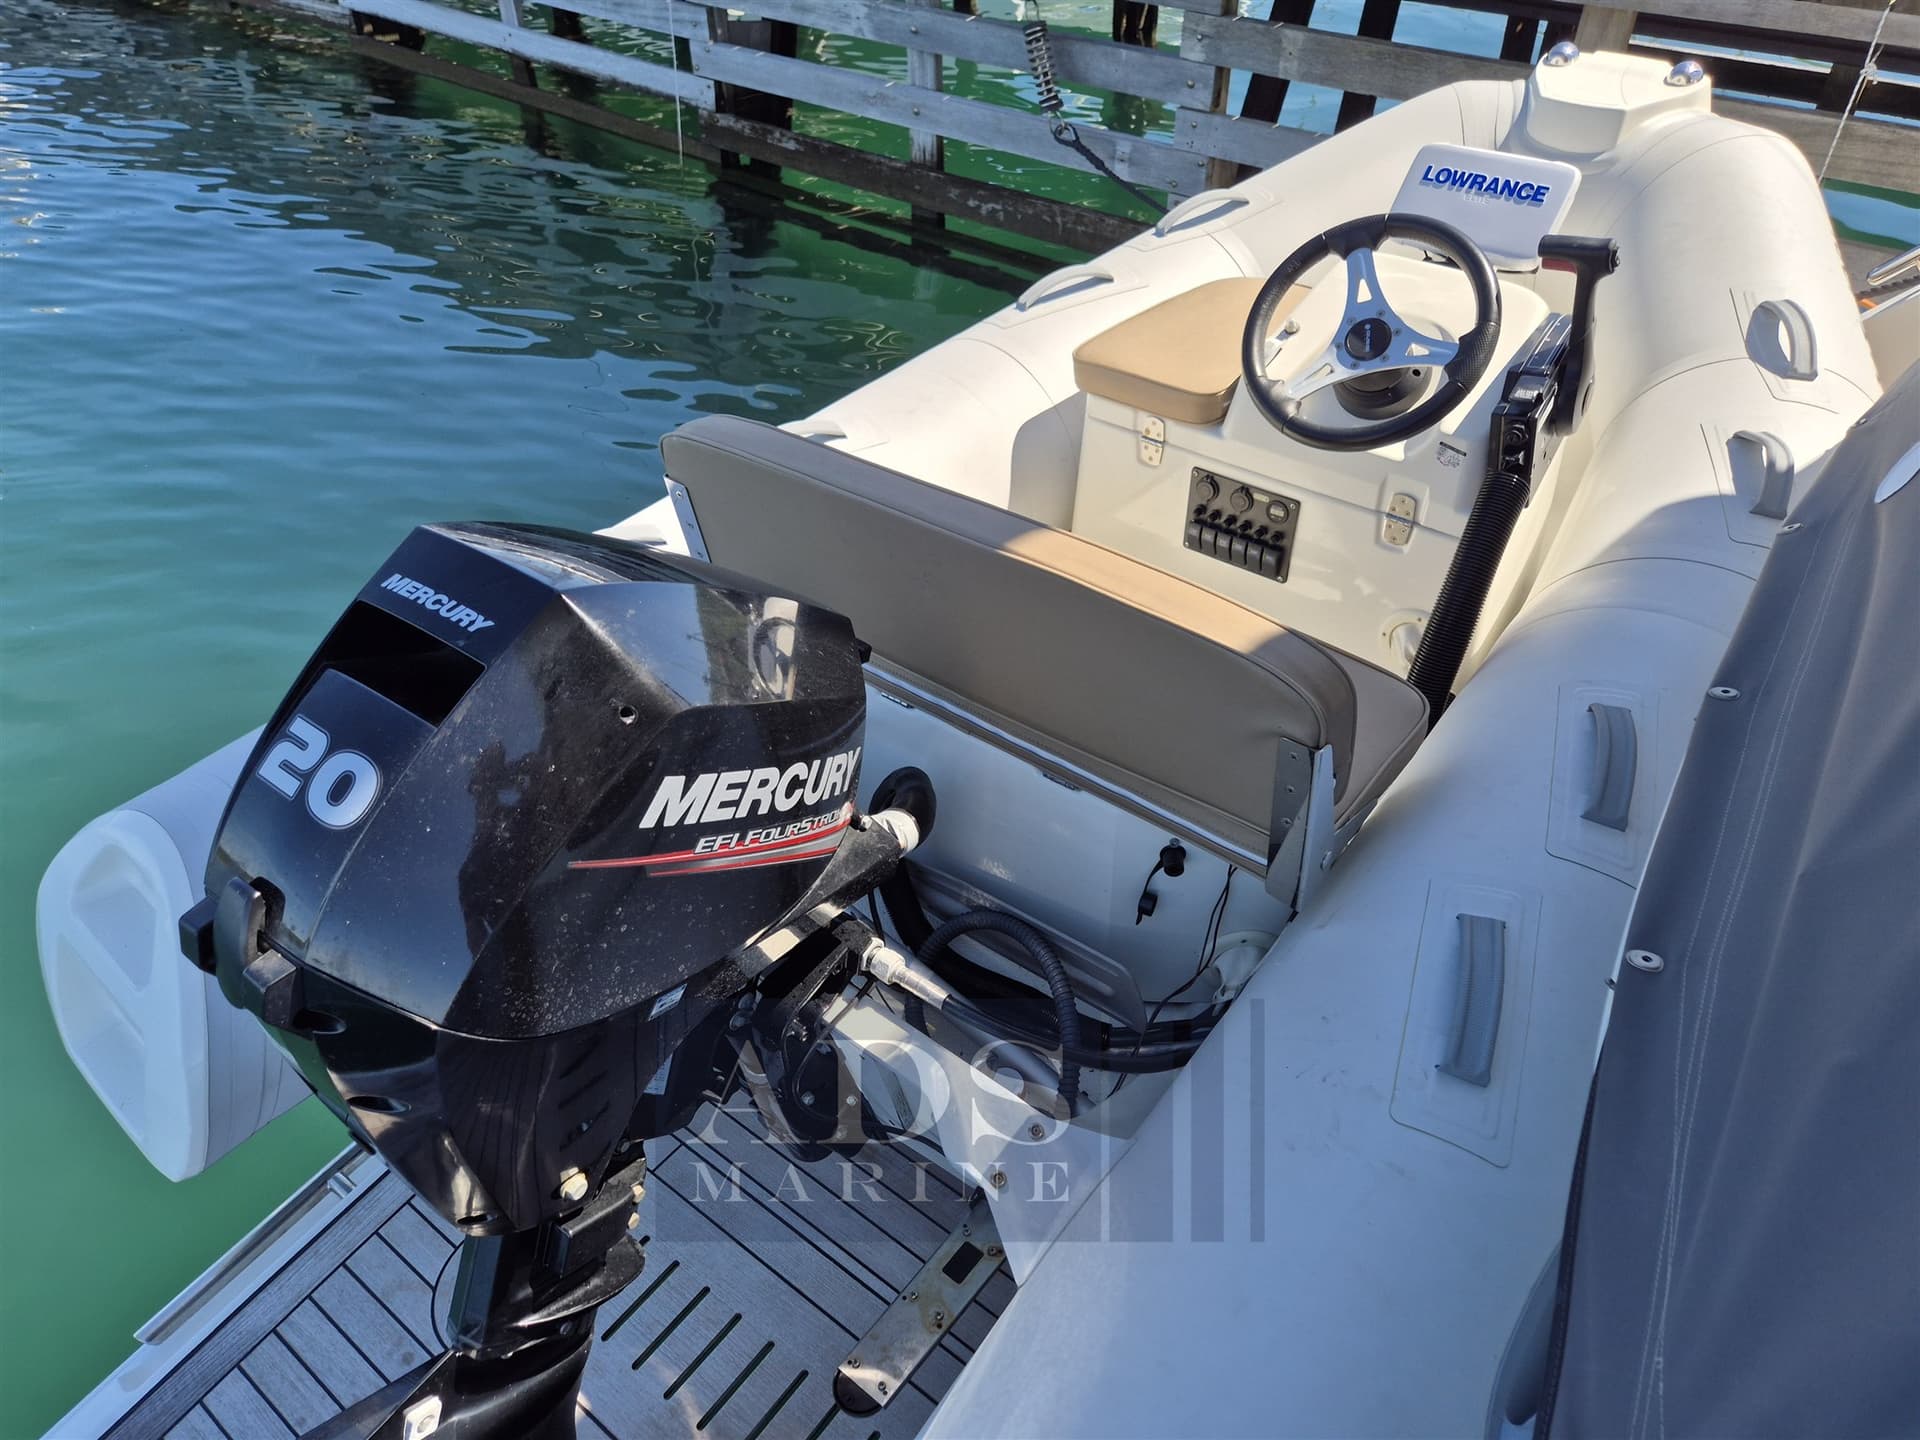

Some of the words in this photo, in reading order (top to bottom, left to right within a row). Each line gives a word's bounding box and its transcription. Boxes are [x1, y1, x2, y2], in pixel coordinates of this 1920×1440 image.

[1420, 164, 1551, 205] LOWRANCE
[380, 572, 496, 633] MERCURY
[256, 713, 383, 830] 20
[638, 746, 862, 830] MERCURY
[694, 831, 740, 855] EFI
